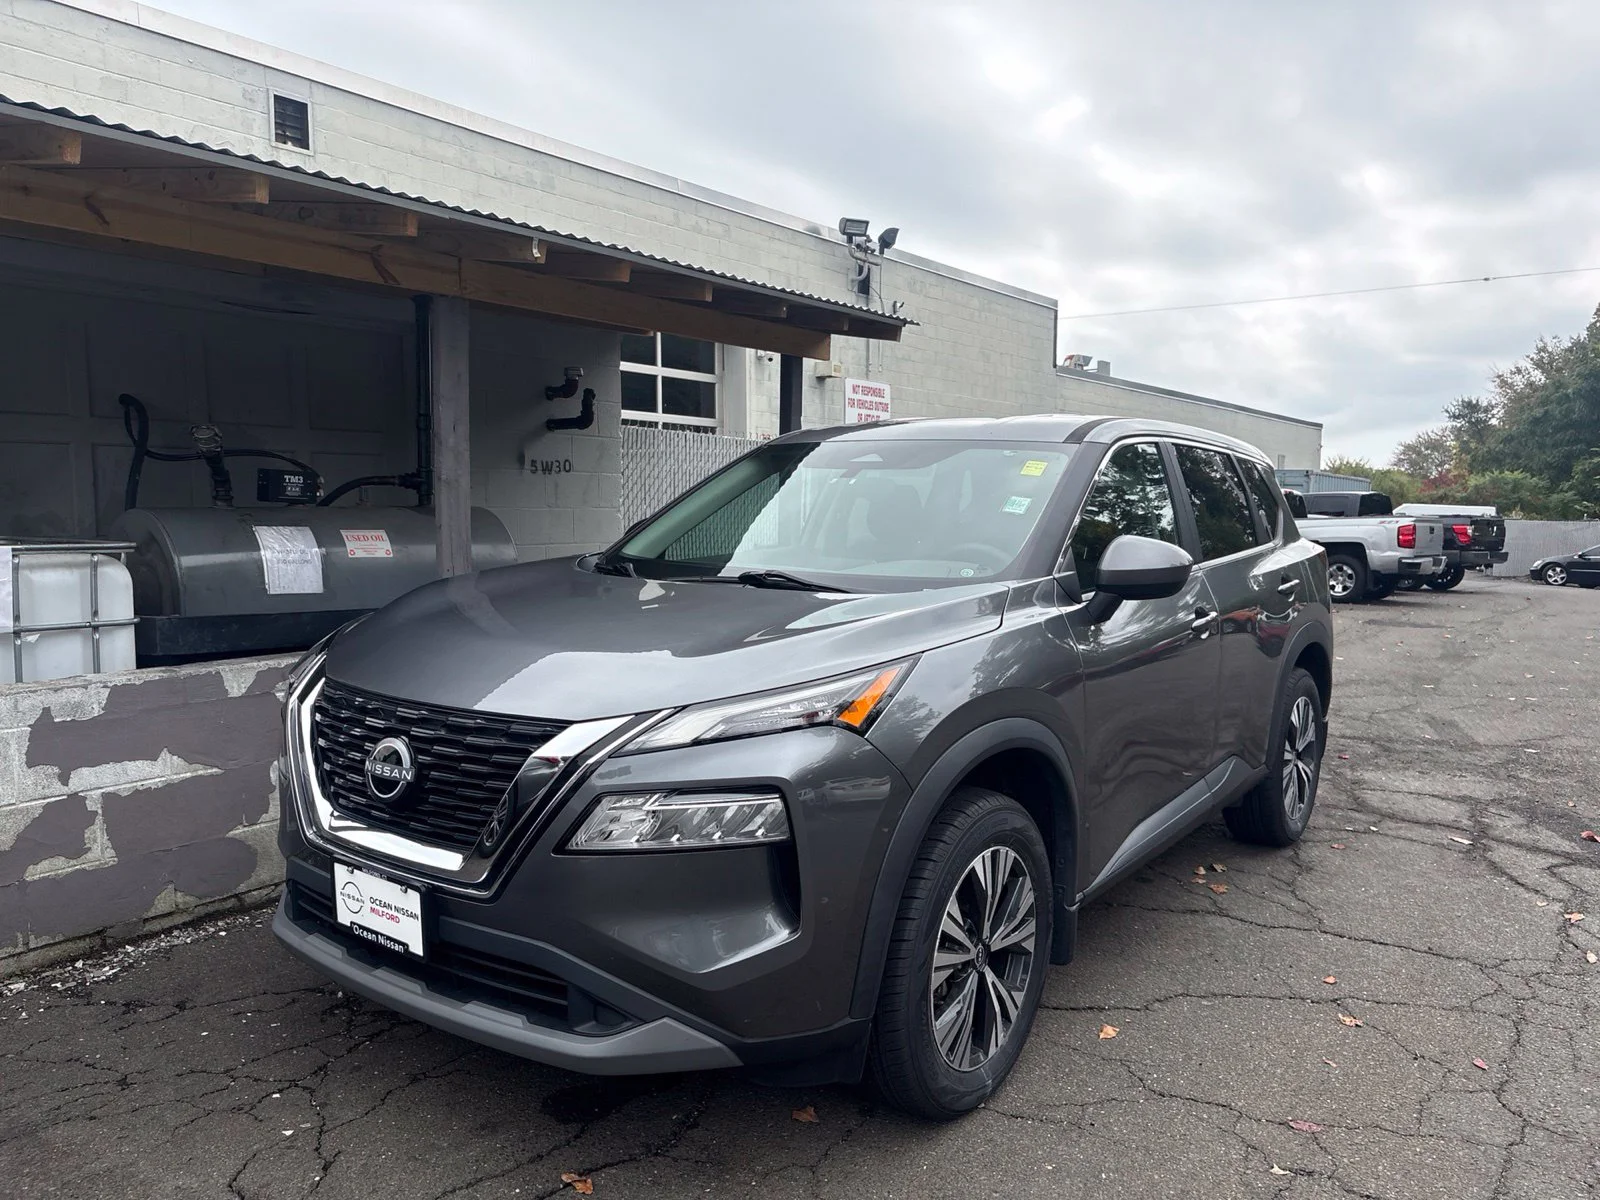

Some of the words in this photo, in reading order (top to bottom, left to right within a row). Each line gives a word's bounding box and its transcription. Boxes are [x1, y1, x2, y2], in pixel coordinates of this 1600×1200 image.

[852, 384, 860, 395] NOT
[861, 385, 885, 399] RESPONSIBLE
[857, 398, 873, 411] VEHICLES
[874, 401, 889, 413] OUTSIDE
[857, 413, 863, 422] OR
[530, 459, 571, 475] 5W30
[284, 475, 304, 483] TM3
[364, 760, 412, 780] NISSAN
[340, 891, 365, 905] NISSAN
[369, 896, 393, 911] OCEAN
[394, 905, 419, 921] NISSAN
[369, 906, 400, 924] MILFORD
[353, 924, 377, 942] Ocean
[378, 934, 404, 954] Nissan
